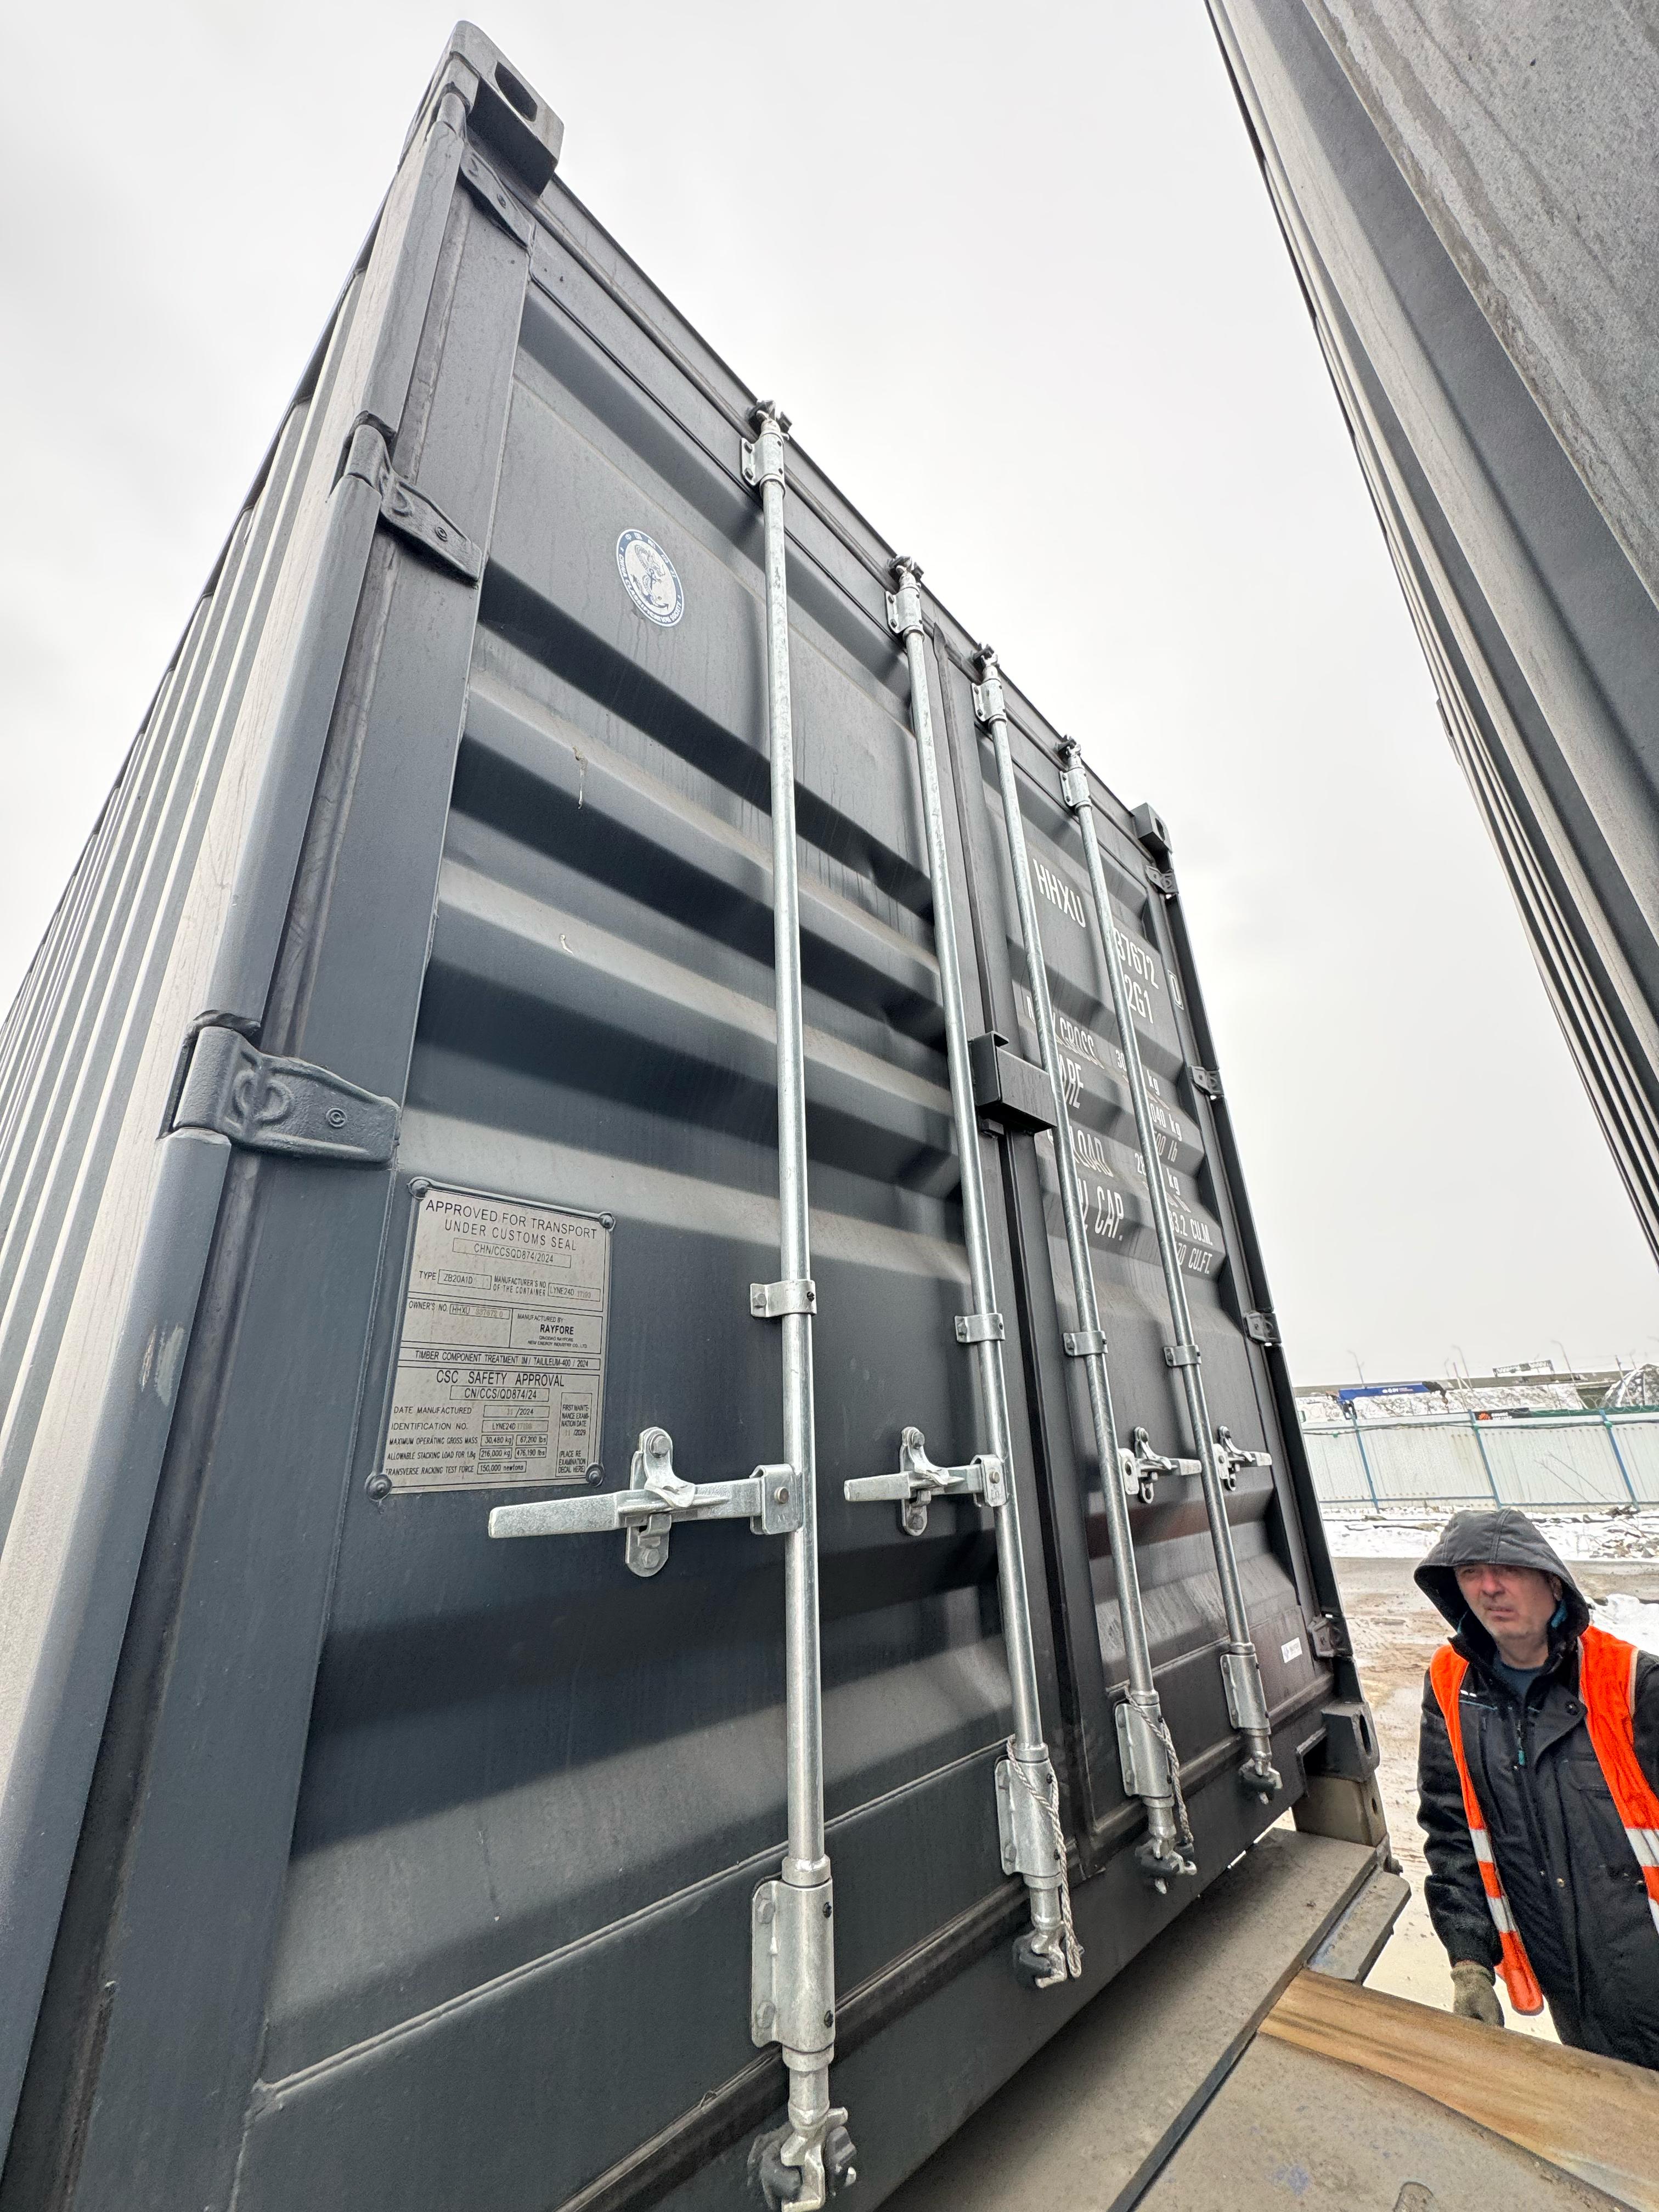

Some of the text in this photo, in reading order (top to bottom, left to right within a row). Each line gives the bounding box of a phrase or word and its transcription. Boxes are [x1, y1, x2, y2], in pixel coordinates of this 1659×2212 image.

[1032, 858, 1086, 928] HHXU
[1147, 1069, 1160, 1096] kg
[1059, 1053, 1084, 1109] ARE
[1169, 1113, 1182, 1142] kg
[1166, 1167, 1181, 1196] kg
[425, 1199, 597, 1239] APPROVED FOR TRANSPORT
[1094, 1186, 1124, 1242] CAP.
[445, 1218, 577, 1251] UNDER CUSTOMS SEAL
[474, 1243, 554, 1263] CHN/CCSQD874/2024
[419, 1271, 437, 1280] TYPE
[494, 1275, 538, 1288] MANUFACTURER'S
[503, 1285, 513, 1293] THE
[516, 1286, 546, 1297] CONTAINER
[409, 1300, 448, 1312] OWNER'S NO.
[452, 1305, 471, 1314] HHXU
[517, 1313, 556, 1323] MANUFACTURED
[540, 1324, 574, 1335] RAYFORE
[415, 1350, 439, 1360] TIMBER
[442, 1352, 482, 1362] COMPONENT
[485, 1355, 519, 1364] TREATMENT
[436, 1369, 565, 1387] CSC SAFETY APPROVAL
[464, 1388, 537, 1400] CN/CCS/QD874/24
[516, 1407, 534, 1418] /2024
[416, 1437, 444, 1445] OPERATING
[505, 1436, 512, 1445] kg
[387, 1452, 415, 1460] ALLOWABLE
[417, 1451, 440, 1459] STACKING
[481, 1449, 503, 1458] 216,000
[386, 1468, 419, 1476] TRANSVERSE
[480, 1464, 501, 1472] 150,000
